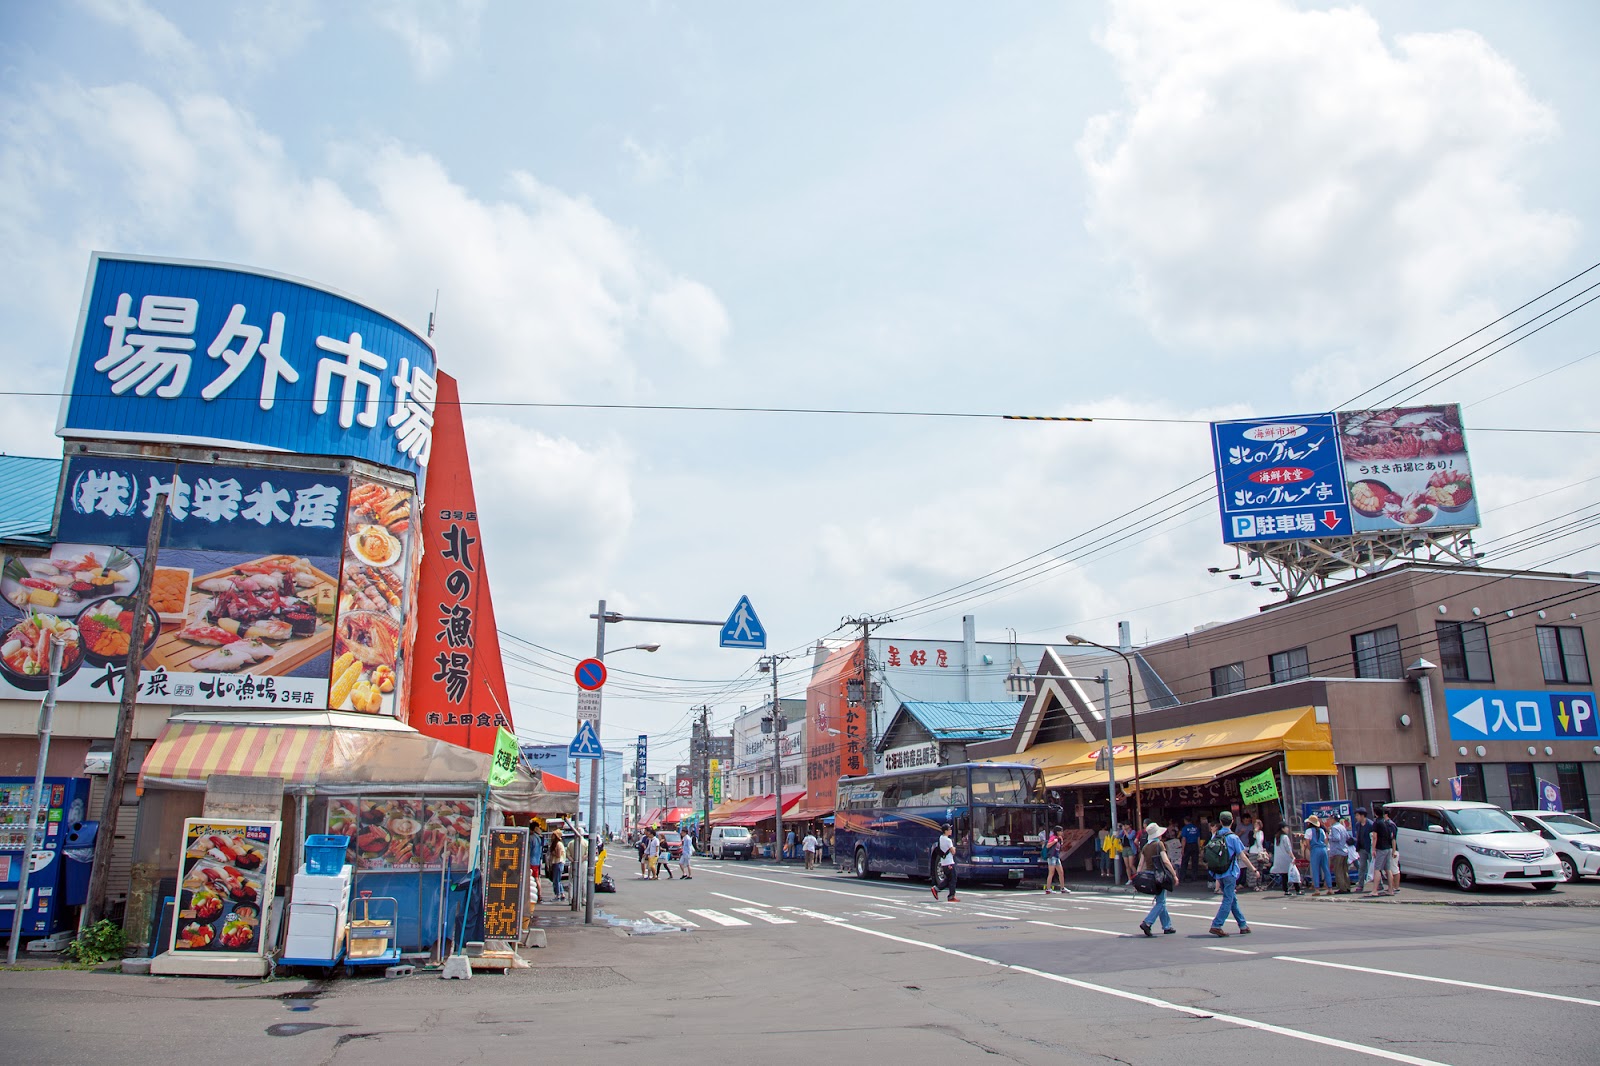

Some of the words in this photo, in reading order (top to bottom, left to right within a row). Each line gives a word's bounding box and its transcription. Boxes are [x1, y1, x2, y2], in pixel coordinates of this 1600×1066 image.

[94, 293, 438, 468] 場外市場
[1253, 424, 1297, 439] 海鮮市場
[1228, 436, 1325, 465] 北のグルメ
[1258, 470, 1304, 482] 海鮮食堂
[1234, 482, 1333, 506] 北のグルメ亭
[440, 510, 477, 521] 3号店
[1237, 519, 1251, 535] P
[1256, 513, 1316, 534] 駐車場
[432, 523, 476, 704] 北の漁場
[887, 645, 949, 668] 美好屋
[90, 663, 171, 697] ヤ衆
[200, 674, 277, 703] 北の漁場
[281, 690, 314, 704] 3号店
[426, 712, 509, 727] (有)上田食品
[1491, 699, 1542, 732] 入口
[1571, 699, 1591, 732] P
[678, 779, 690, 794] かに
[1342, 805, 1347, 814] P
